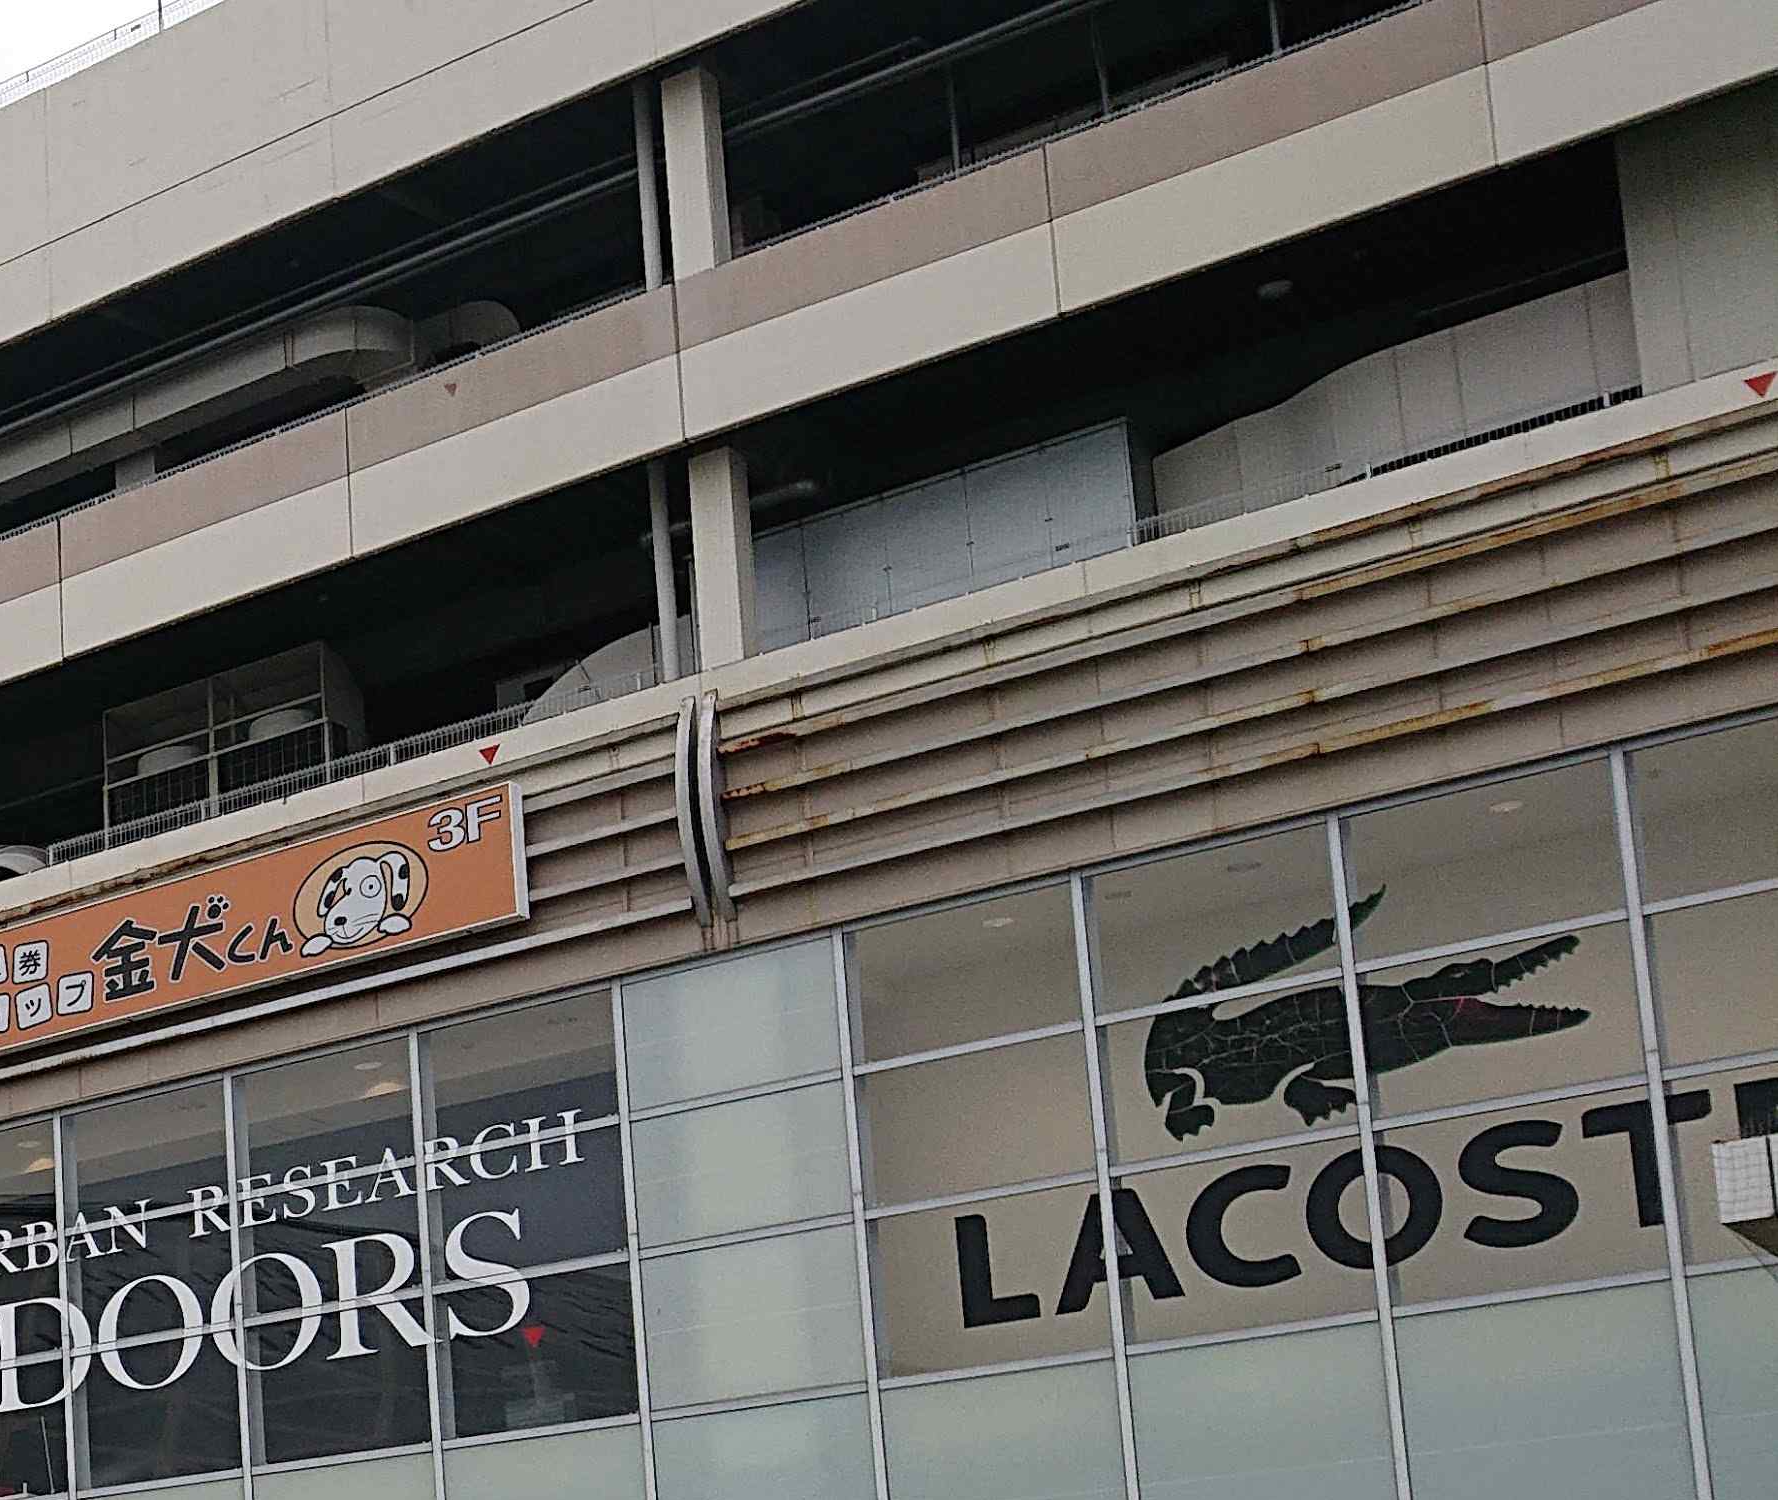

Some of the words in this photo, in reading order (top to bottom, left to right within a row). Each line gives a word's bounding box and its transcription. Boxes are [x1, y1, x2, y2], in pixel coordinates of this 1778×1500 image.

[427, 796, 503, 852] 3F
[92, 896, 293, 1001] 金犬くん
[187, 1108, 585, 1239] RESEARCH
